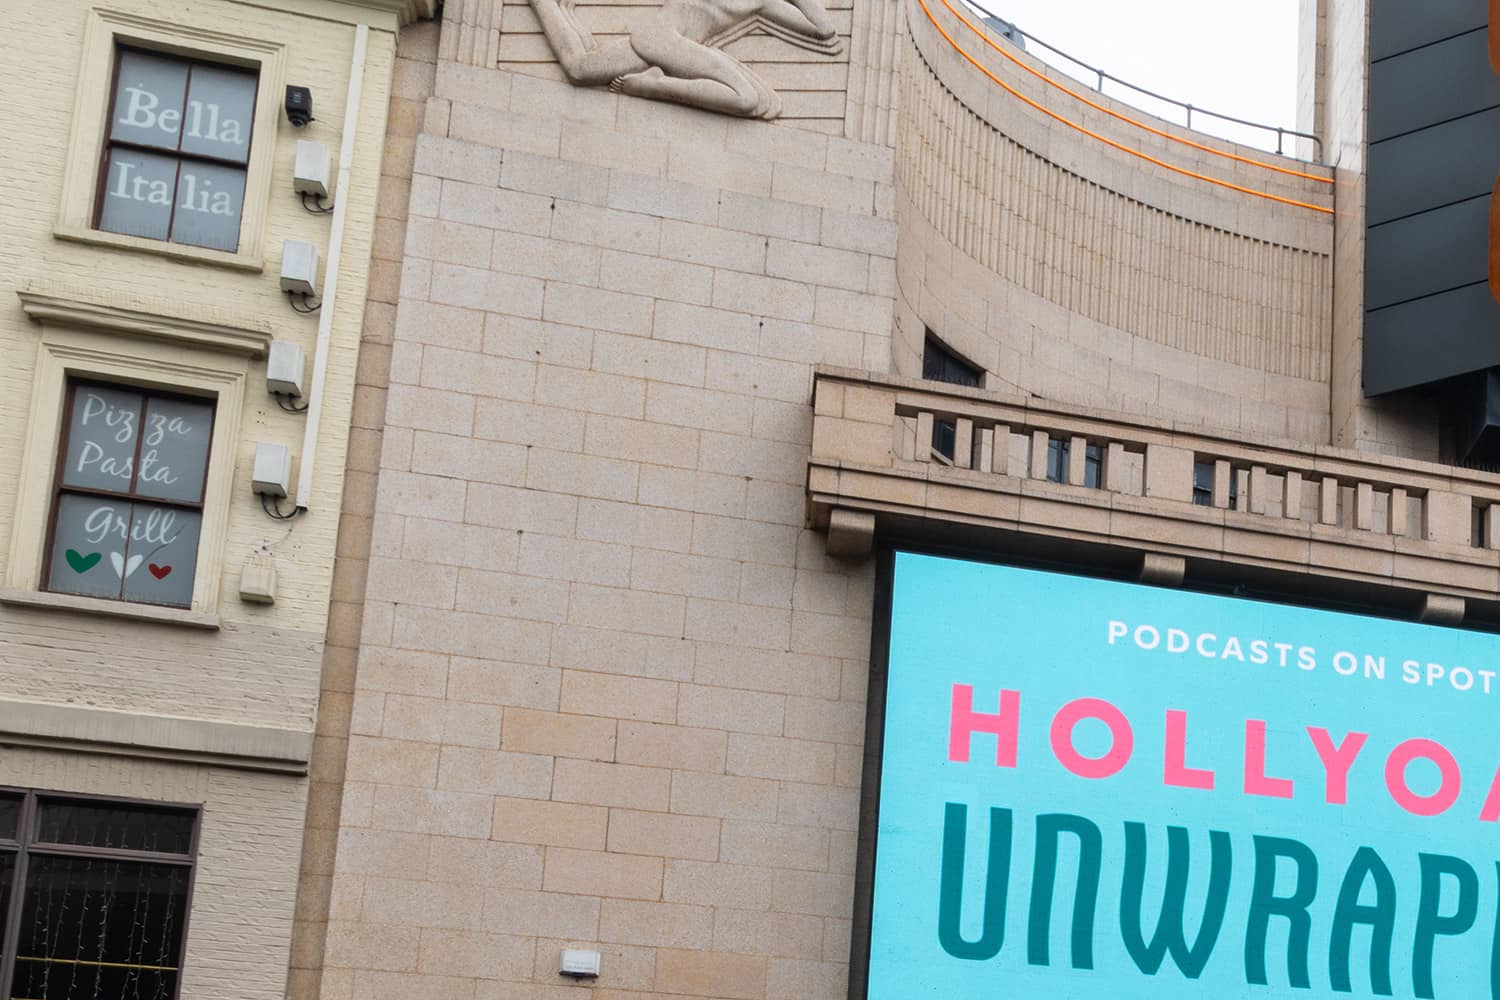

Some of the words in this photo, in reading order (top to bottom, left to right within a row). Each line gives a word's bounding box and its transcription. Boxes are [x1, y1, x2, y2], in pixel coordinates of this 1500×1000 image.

[118, 83, 245, 147] Bella
[109, 161, 236, 218] Italia
[80, 394, 193, 446] Pizza
[76, 440, 181, 488] Pasta
[84, 504, 181, 547] Grill
[1107, 619, 1318, 671] PODCASTS
[1332, 649, 1388, 680] ON
